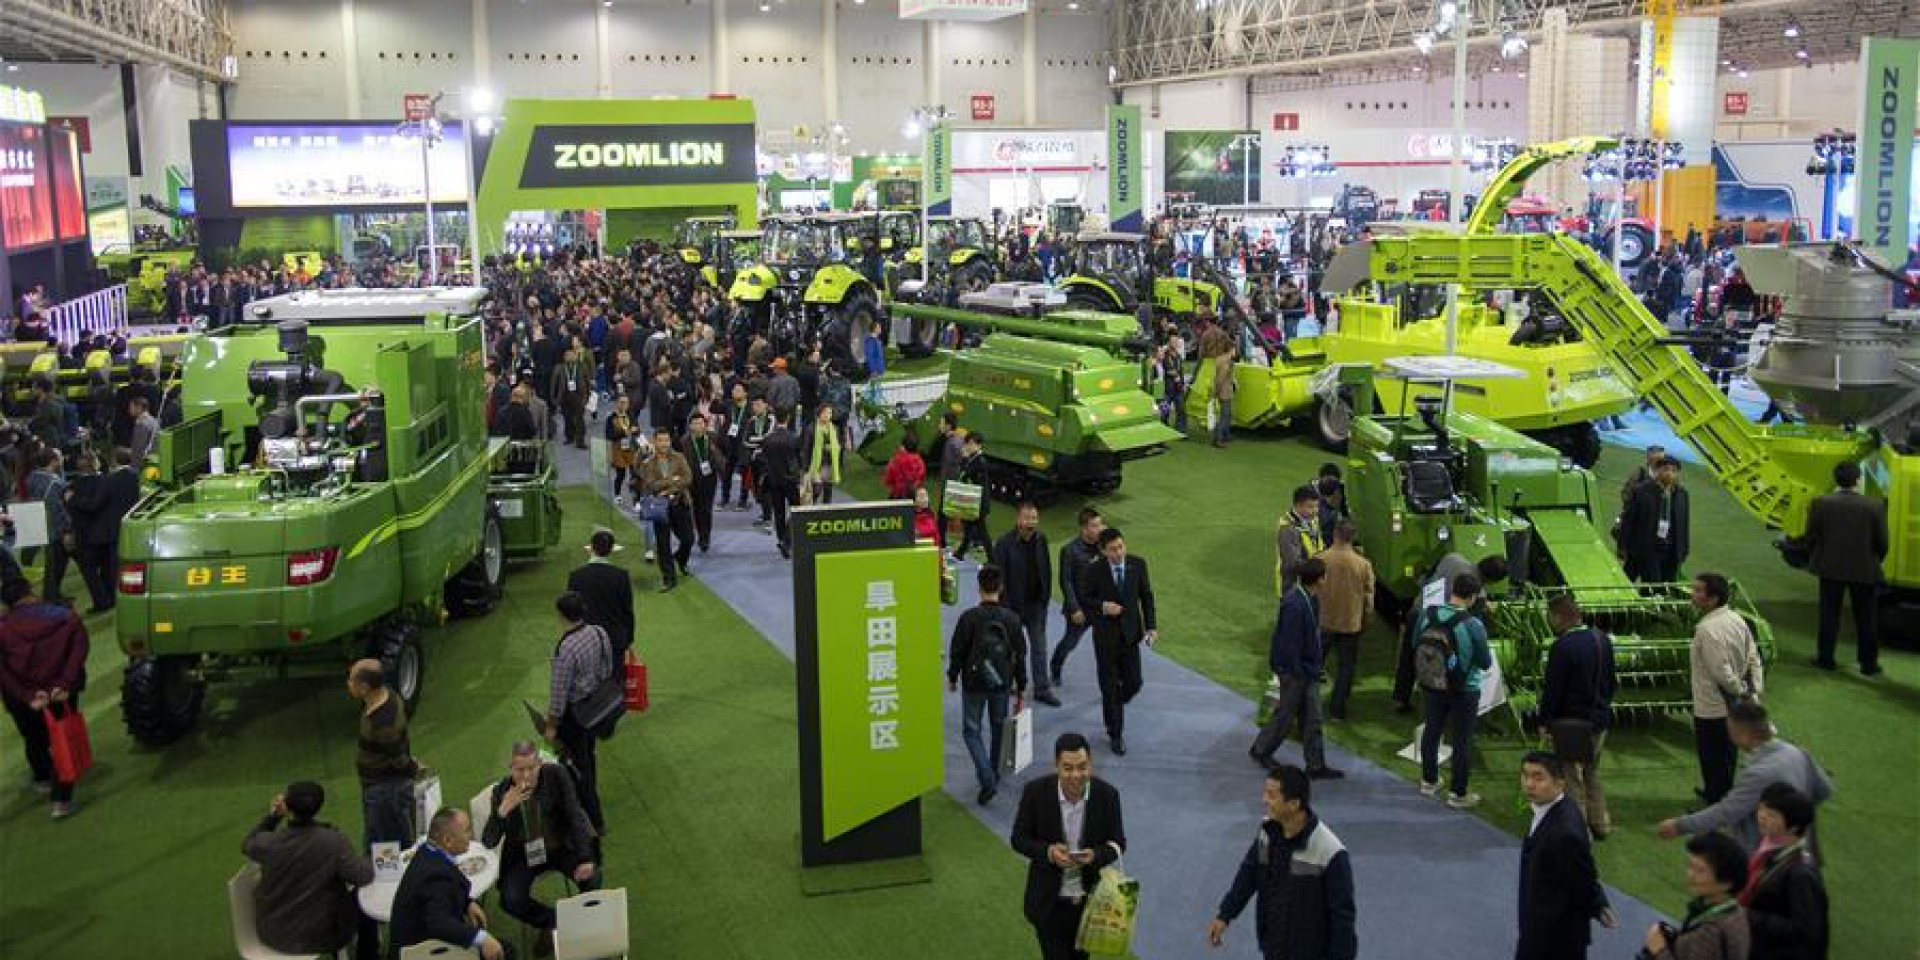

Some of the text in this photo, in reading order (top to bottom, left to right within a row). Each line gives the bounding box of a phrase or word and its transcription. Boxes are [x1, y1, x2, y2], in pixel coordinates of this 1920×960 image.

[554, 141, 725, 169] ZOOMLION
[1117, 118, 1128, 202] ZOOMLION
[1875, 67, 1900, 247] ZOOMLION
[806, 515, 903, 535] ZOOMLION
[865, 579, 899, 750] 旱田展示区
